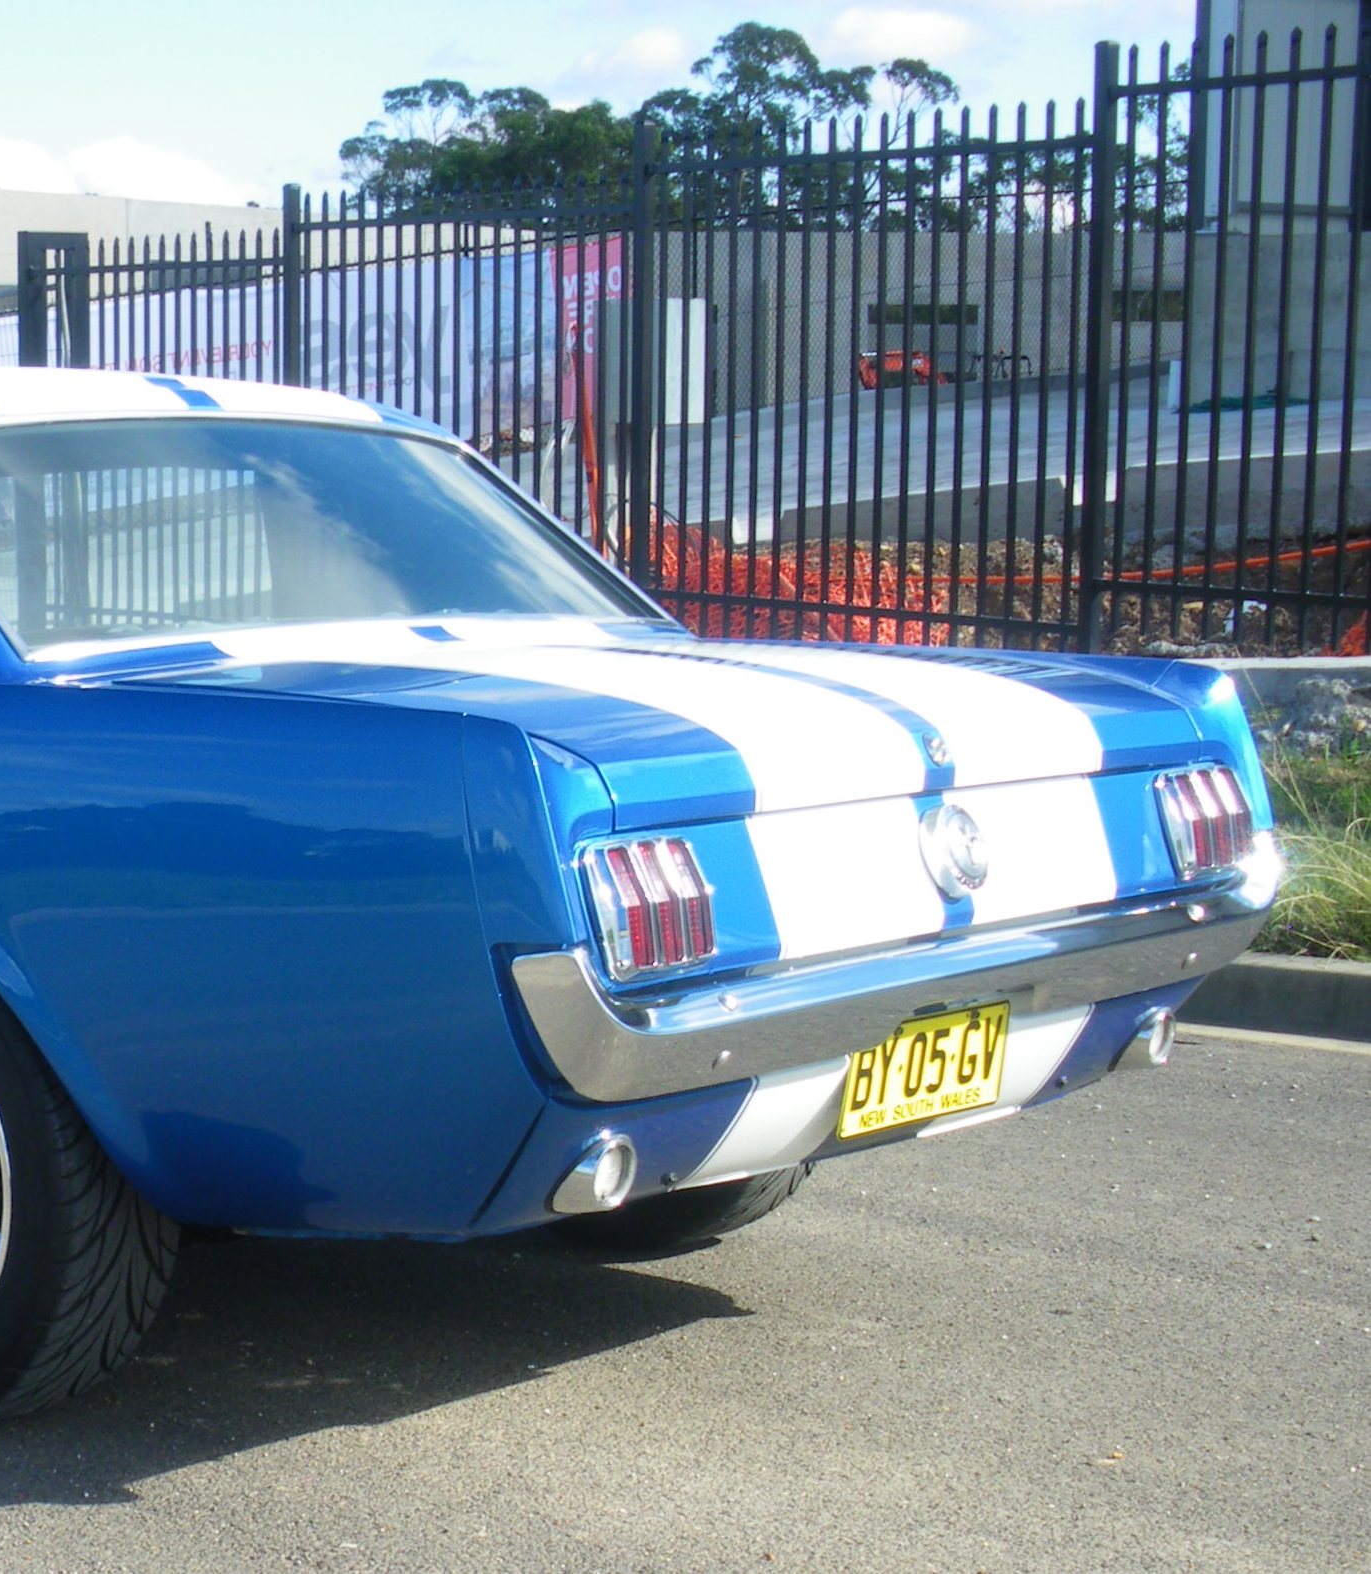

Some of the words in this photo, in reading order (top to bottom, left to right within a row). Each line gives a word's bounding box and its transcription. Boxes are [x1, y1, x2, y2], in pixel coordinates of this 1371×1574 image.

[859, 1107, 886, 1128] NEW
[892, 1097, 934, 1121] SOUTH
[940, 1087, 981, 1109] WALES
